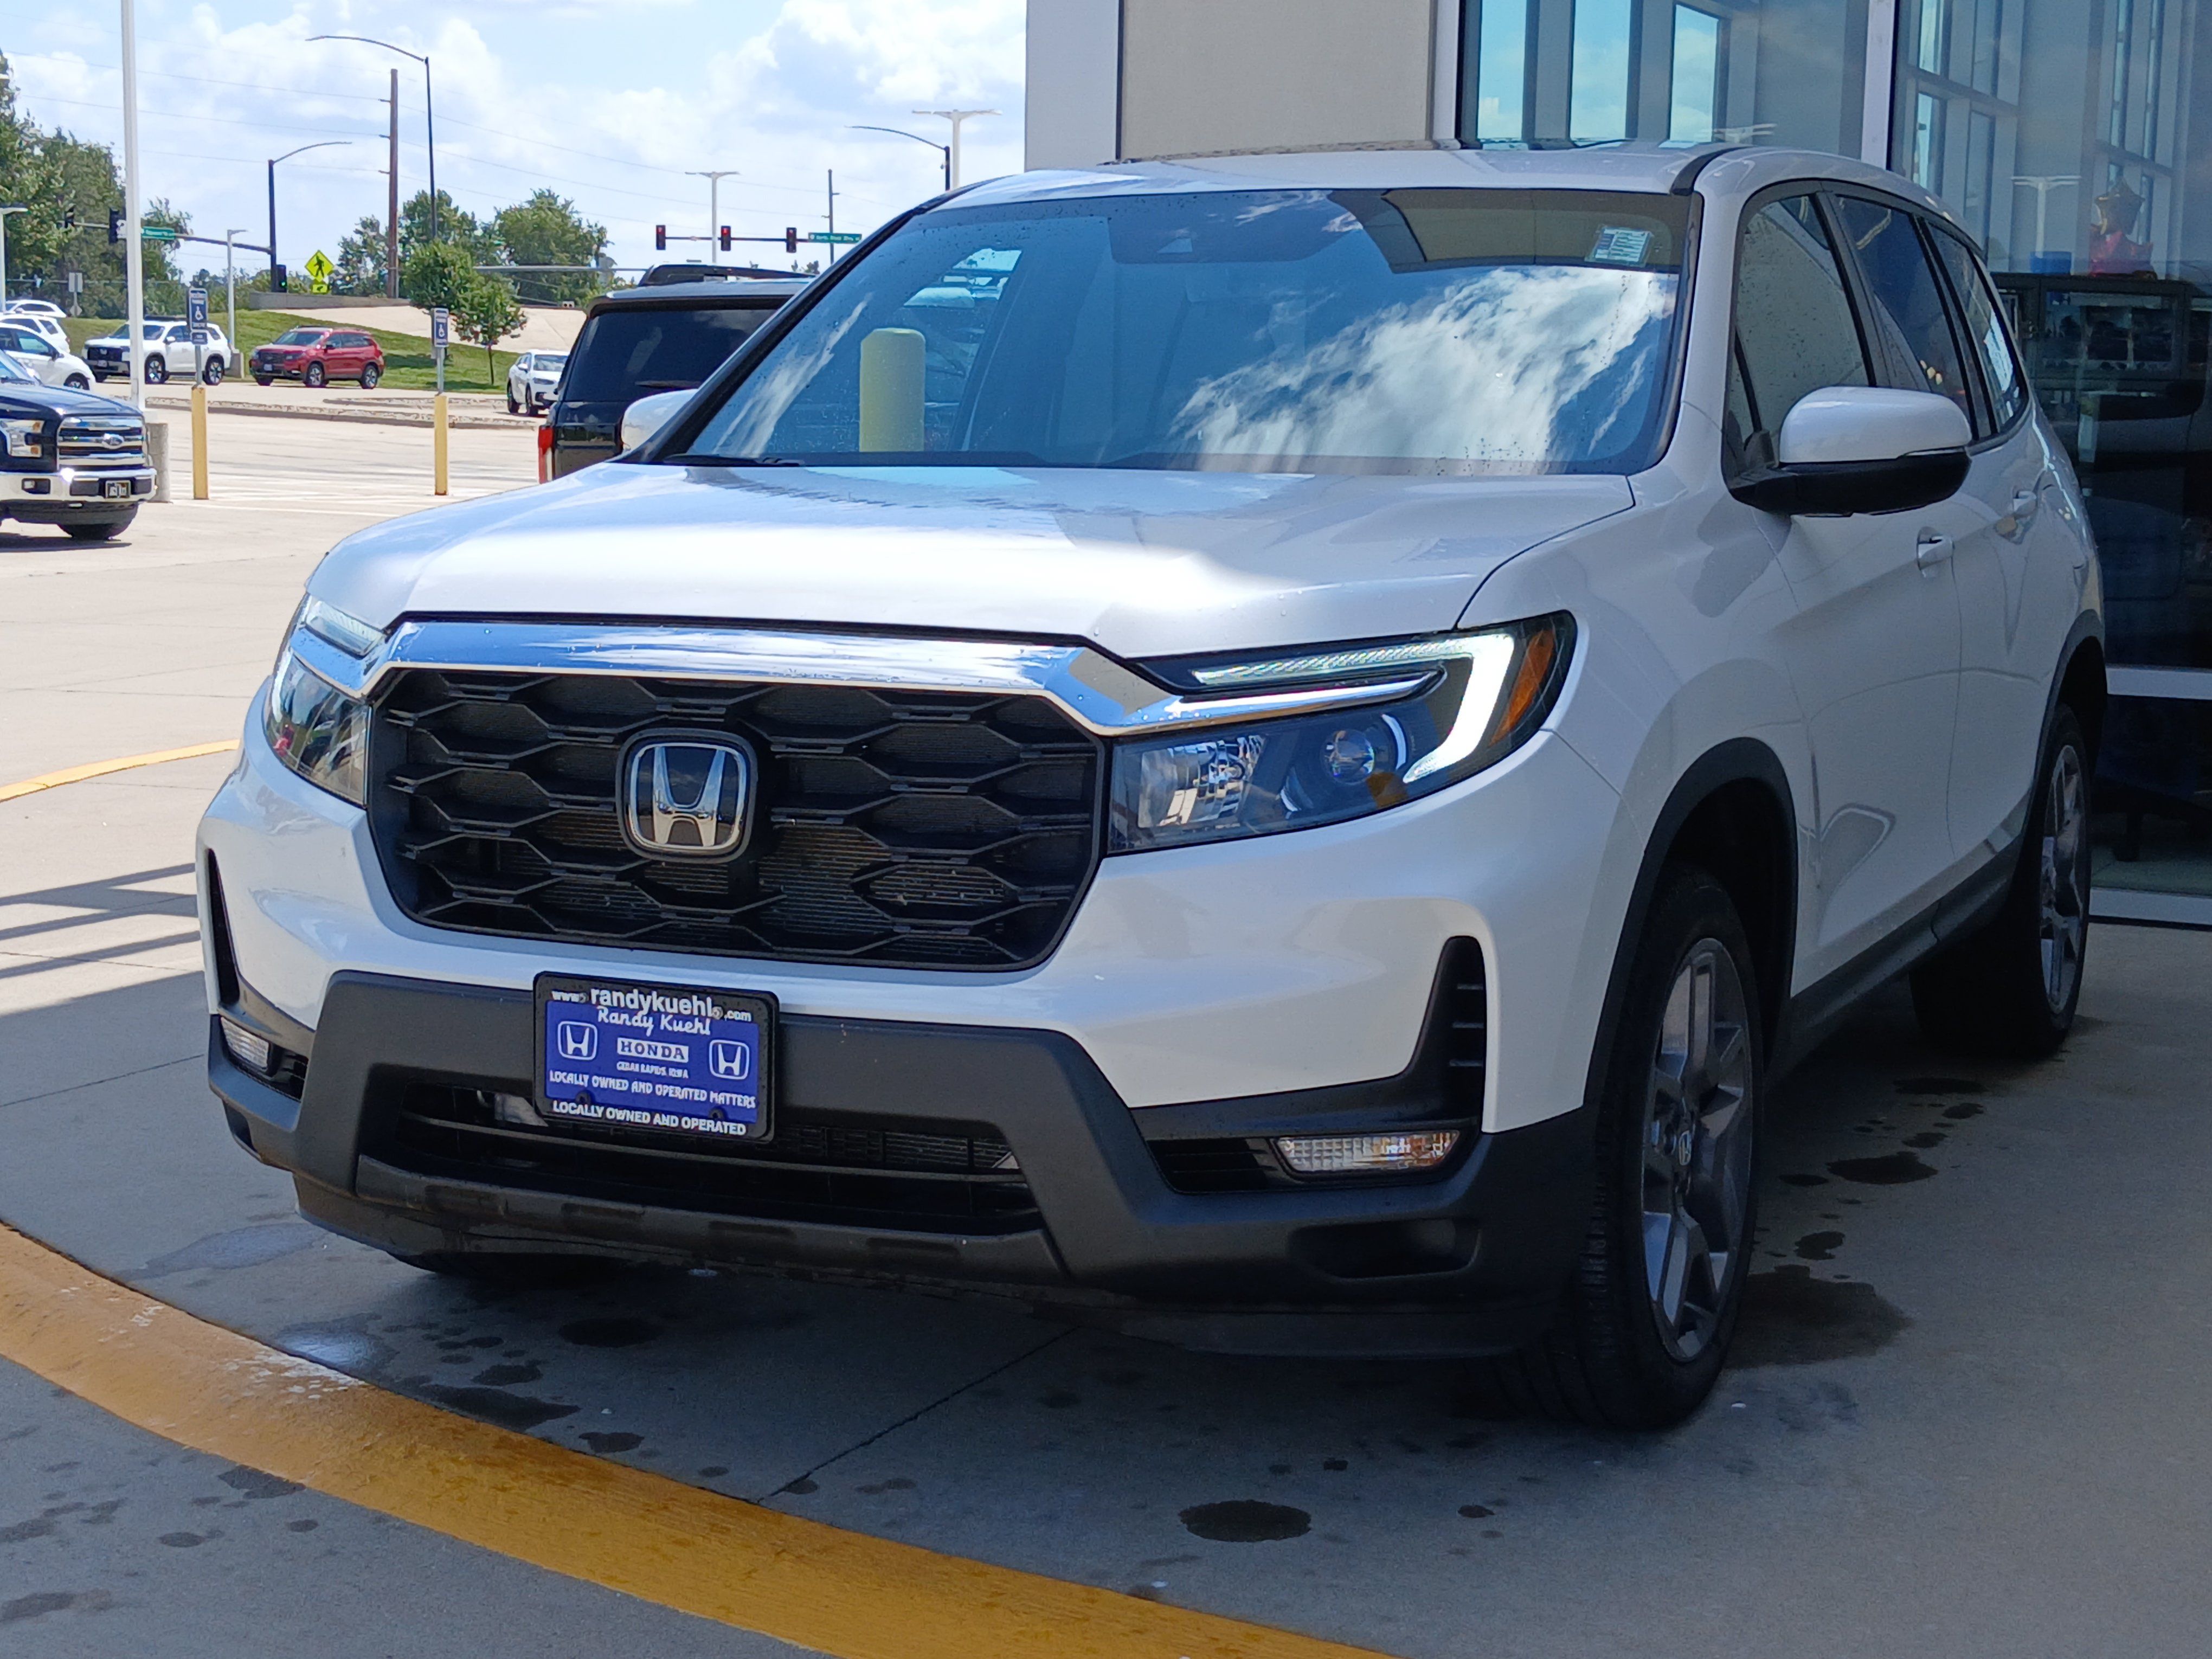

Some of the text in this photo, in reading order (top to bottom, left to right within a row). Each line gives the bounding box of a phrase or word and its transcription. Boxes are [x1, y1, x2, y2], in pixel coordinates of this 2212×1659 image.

[597, 1005, 711, 1037] Randy Kuehl
[621, 1040, 685, 1060] HONDA
[549, 1070, 756, 1109] LOCALLY OWNED AND OPERATED MATTERS
[552, 1100, 747, 1136] LOCALLY OWNED AND OPERATED
